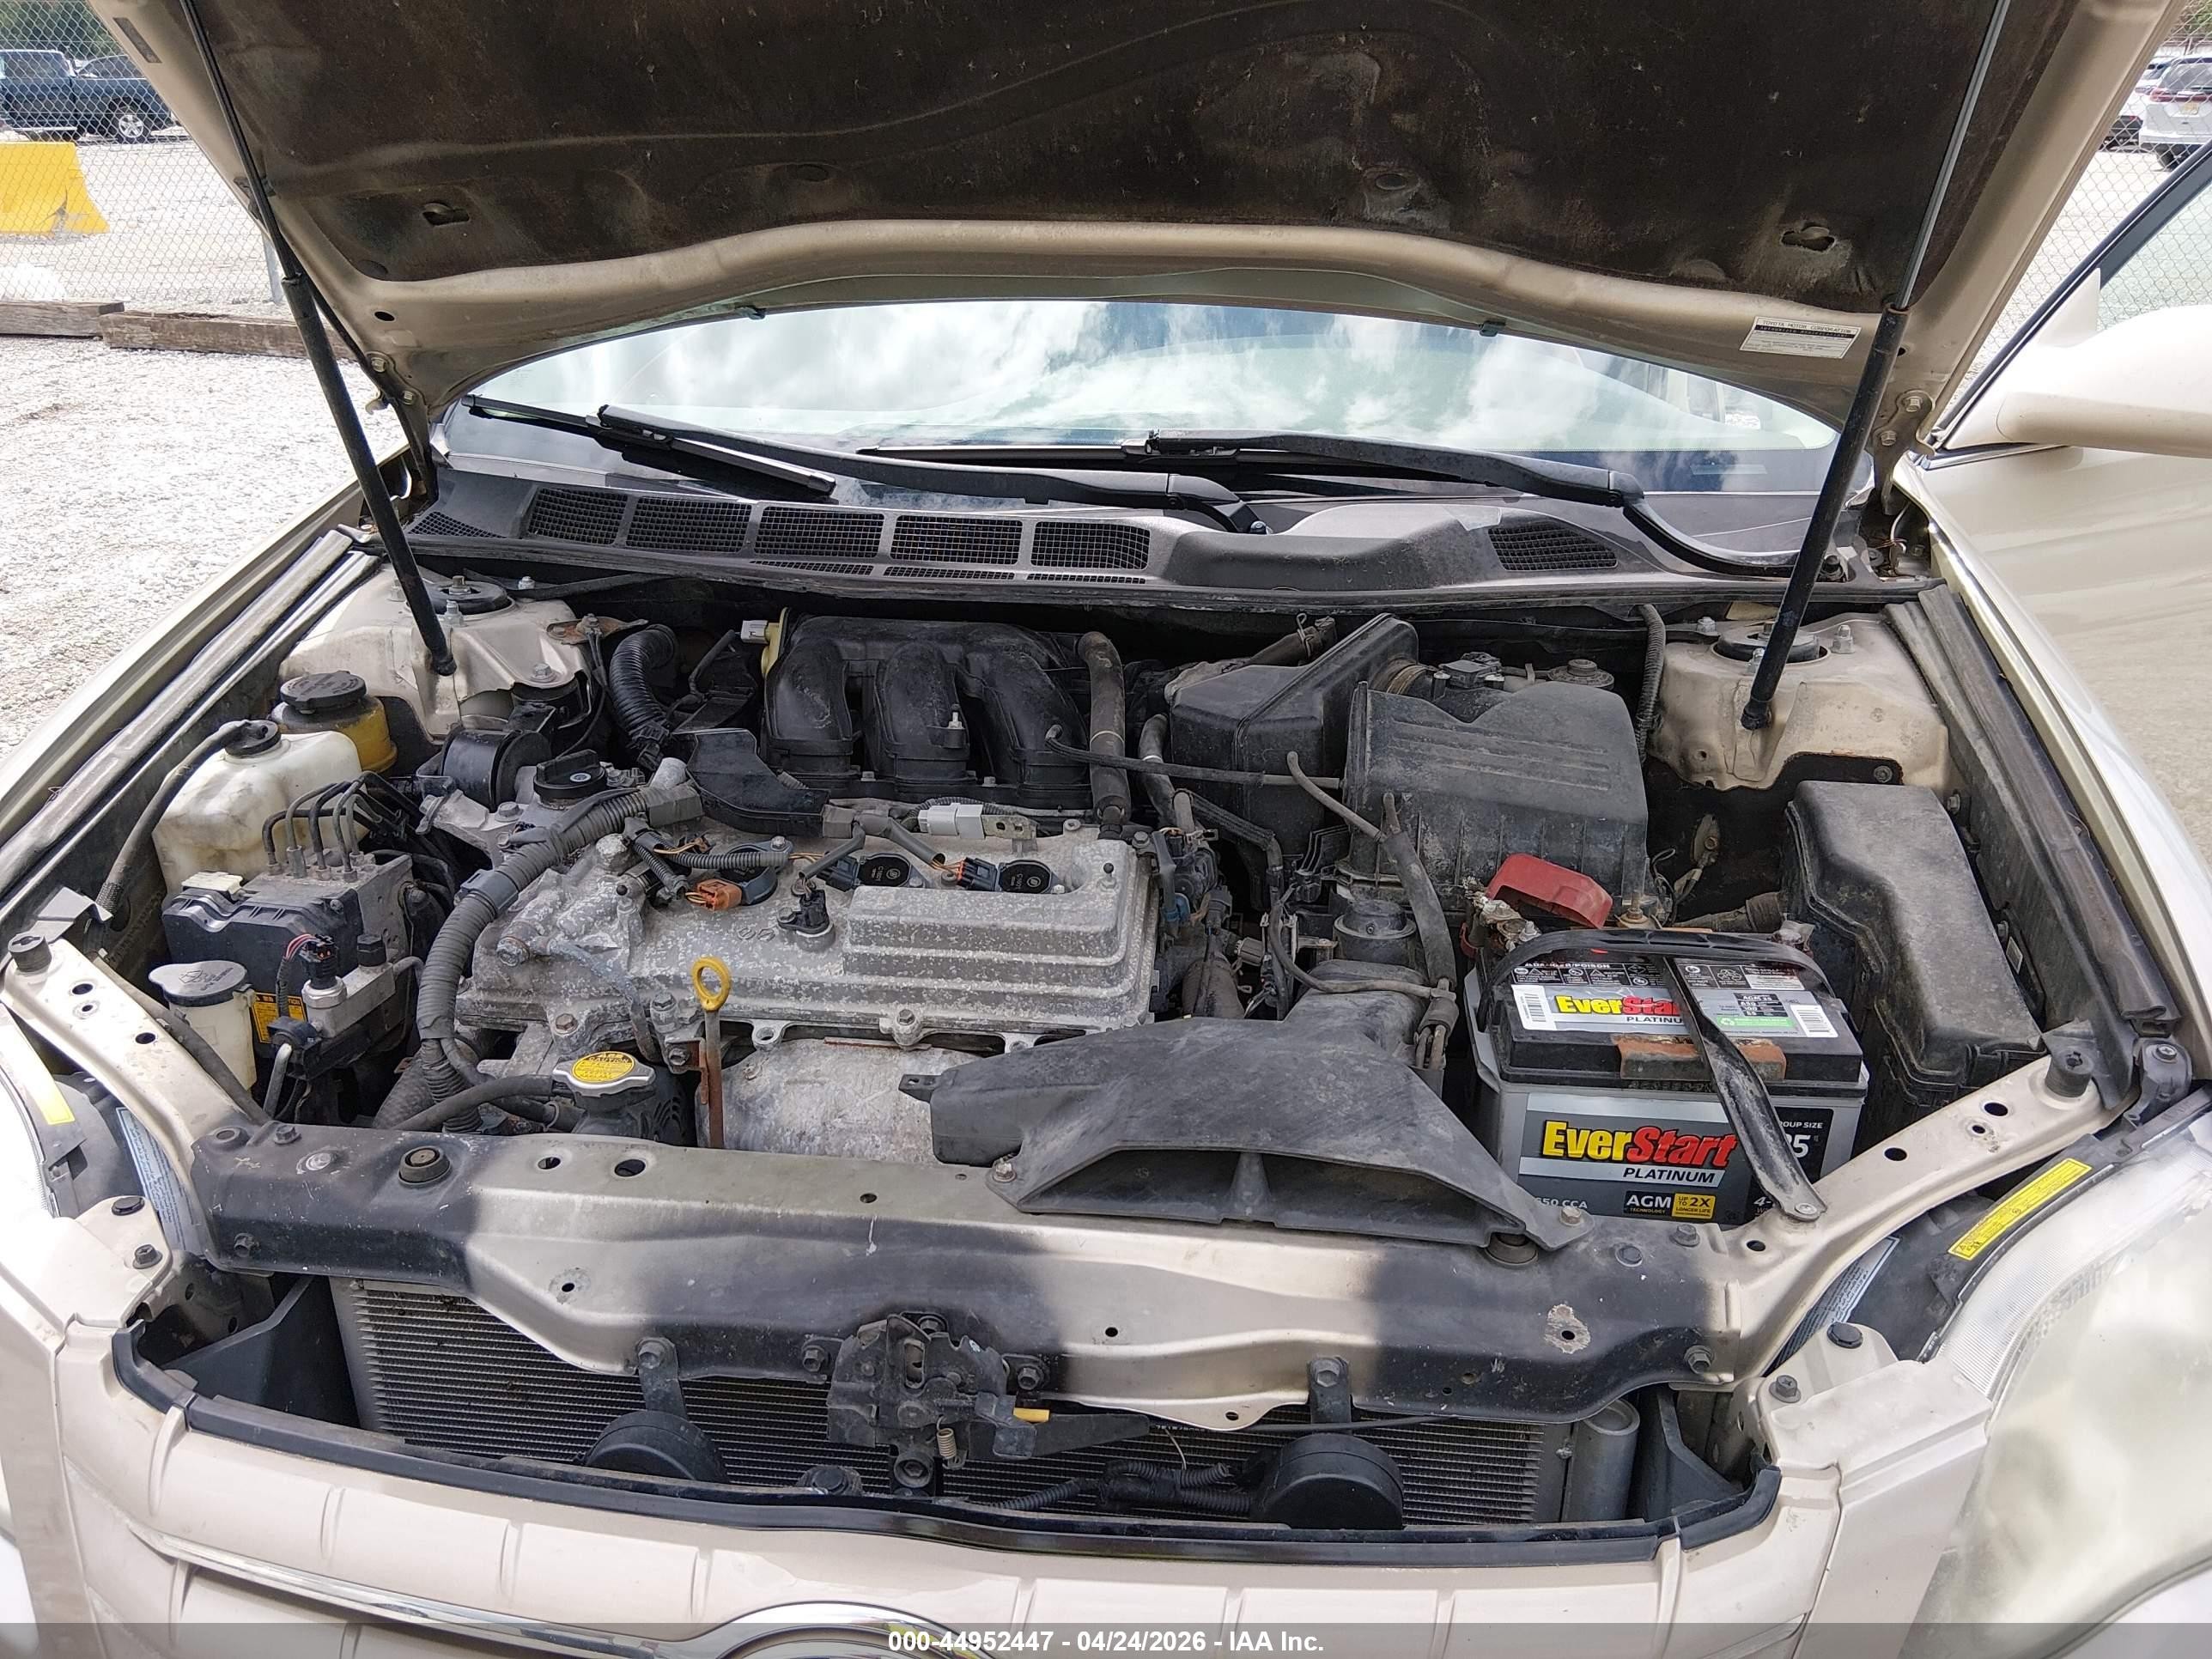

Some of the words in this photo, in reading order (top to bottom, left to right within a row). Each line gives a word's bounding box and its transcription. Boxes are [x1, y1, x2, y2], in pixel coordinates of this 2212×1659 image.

[1810, 325, 1852, 334] CORPORATION
[1555, 994, 1680, 1017] EverSta
[1541, 1120, 1739, 1168] EverStart
[1623, 1167, 1716, 1183] PLATINUM
[1562, 1199, 1588, 1209] CCA
[1626, 1194, 1672, 1208] AGM
[1689, 1197, 1711, 1207] 2X
